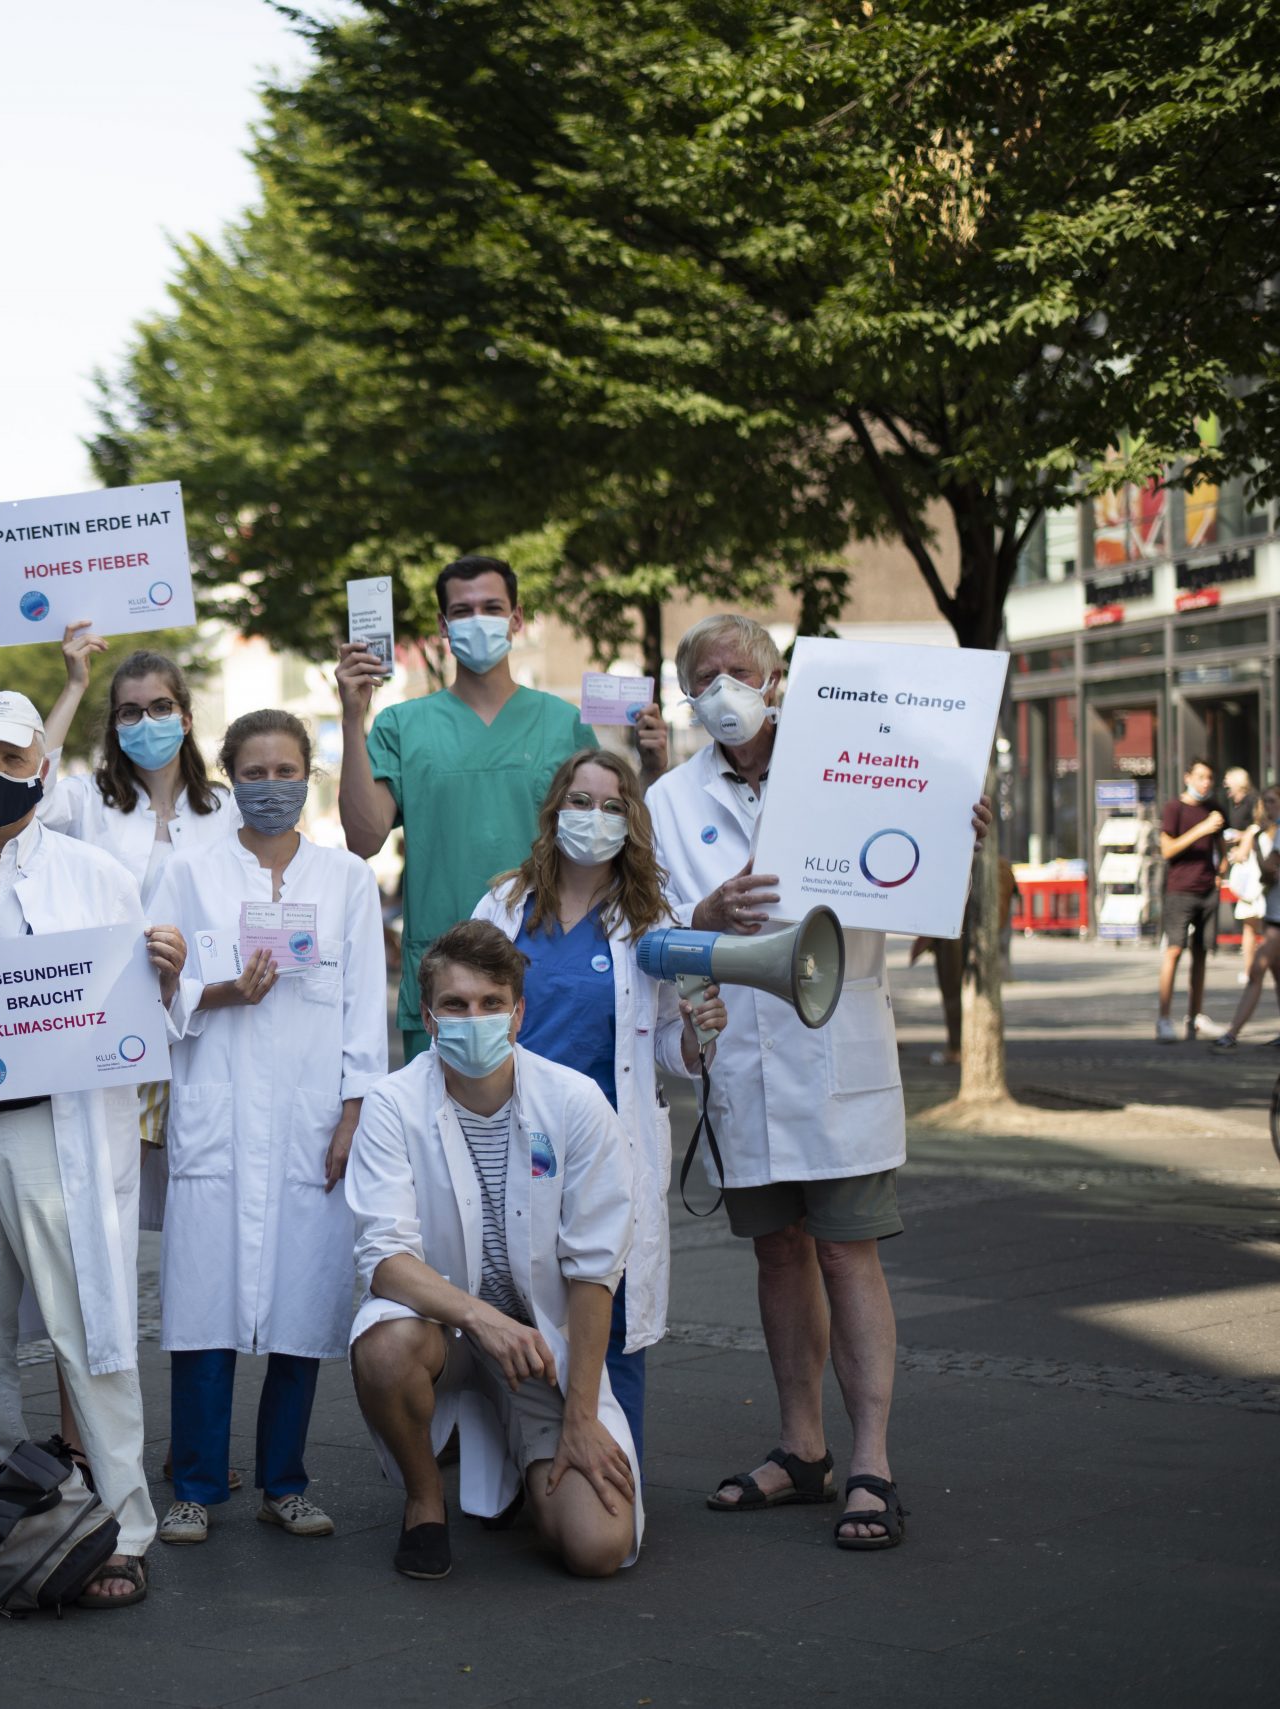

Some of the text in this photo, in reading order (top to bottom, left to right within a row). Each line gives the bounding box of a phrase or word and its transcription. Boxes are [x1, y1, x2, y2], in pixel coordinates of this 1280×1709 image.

[85, 516, 132, 533] ERDE
[136, 510, 171, 527] HAT
[24, 552, 149, 579] HOHES FIEBER
[817, 686, 966, 712] Climate Change
[878, 723, 891, 734] is
[838, 751, 919, 769] A Health
[822, 769, 928, 792] Emergency
[804, 856, 850, 873] KLUG
[802, 876, 853, 887] Deutsche Allianz
[801, 885, 839, 895] Klimawandel
[853, 890, 888, 900] Gesundheit
[232, 944, 242, 975] Gemeinsam
[6, 988, 84, 1010] BRAUCHT
[95, 1053, 117, 1062] KLUG
